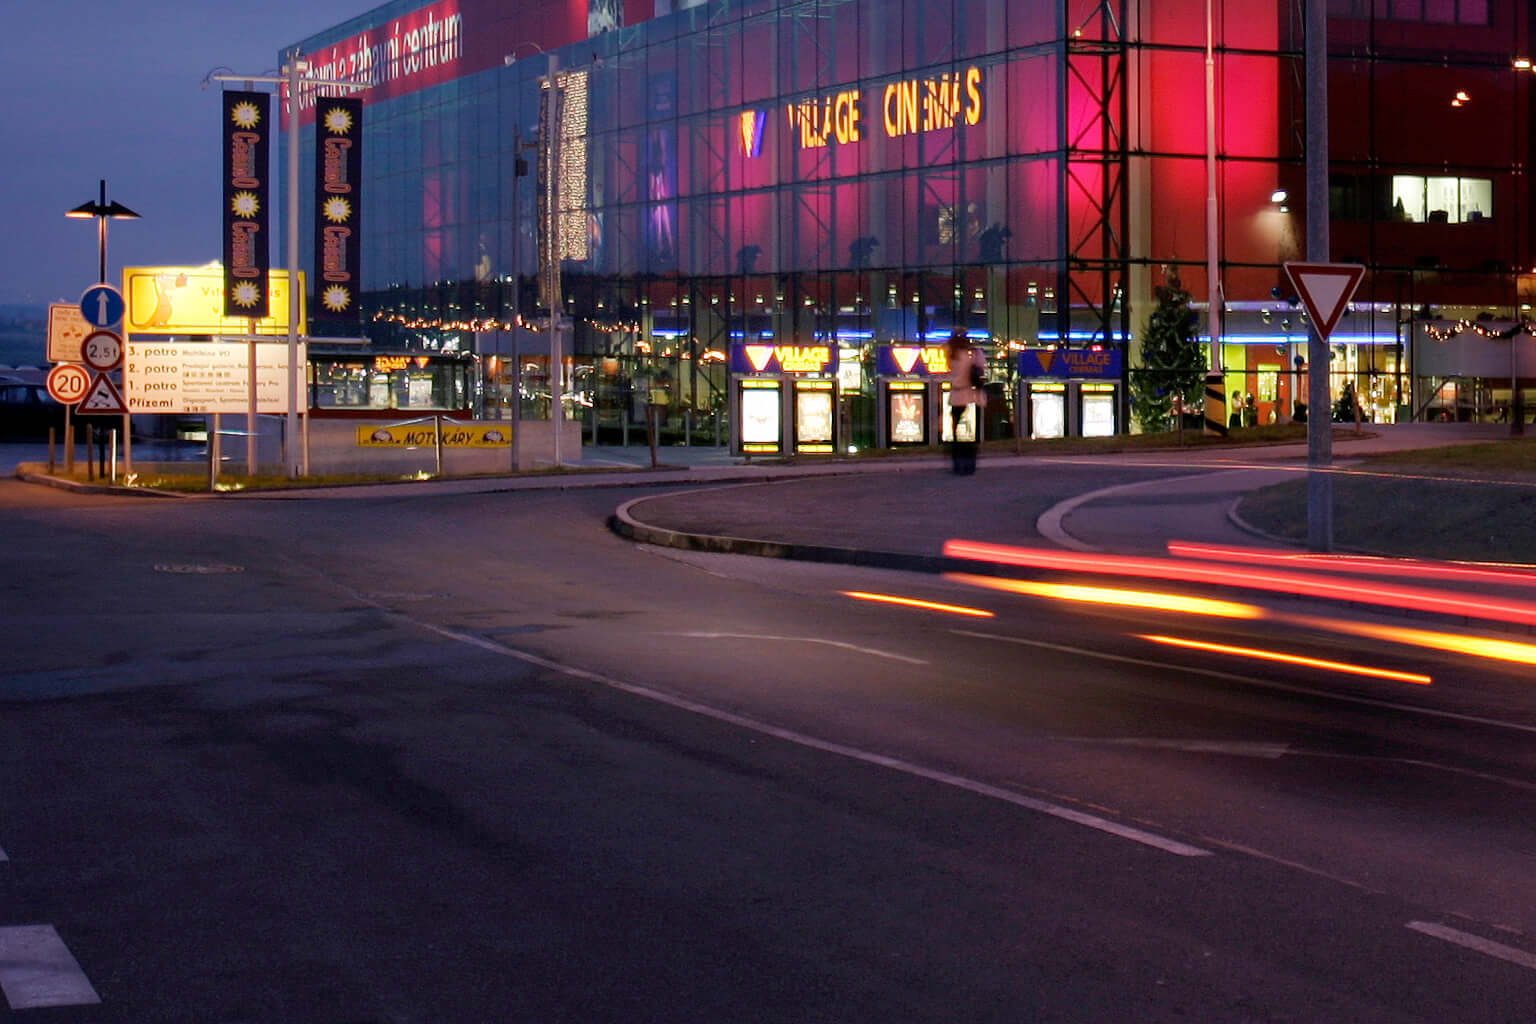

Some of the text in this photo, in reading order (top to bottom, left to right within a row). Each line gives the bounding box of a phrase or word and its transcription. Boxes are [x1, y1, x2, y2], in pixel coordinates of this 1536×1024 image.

[338, 57, 347, 97] a
[350, 22, 400, 94] zábavní
[402, 12, 463, 76] centrum
[129, 346, 140, 356] 3.
[1062, 352, 1111, 366] VILLAGE
[129, 363, 140, 374] 2.
[56, 374, 82, 394] 20
[129, 380, 139, 390] 1.
